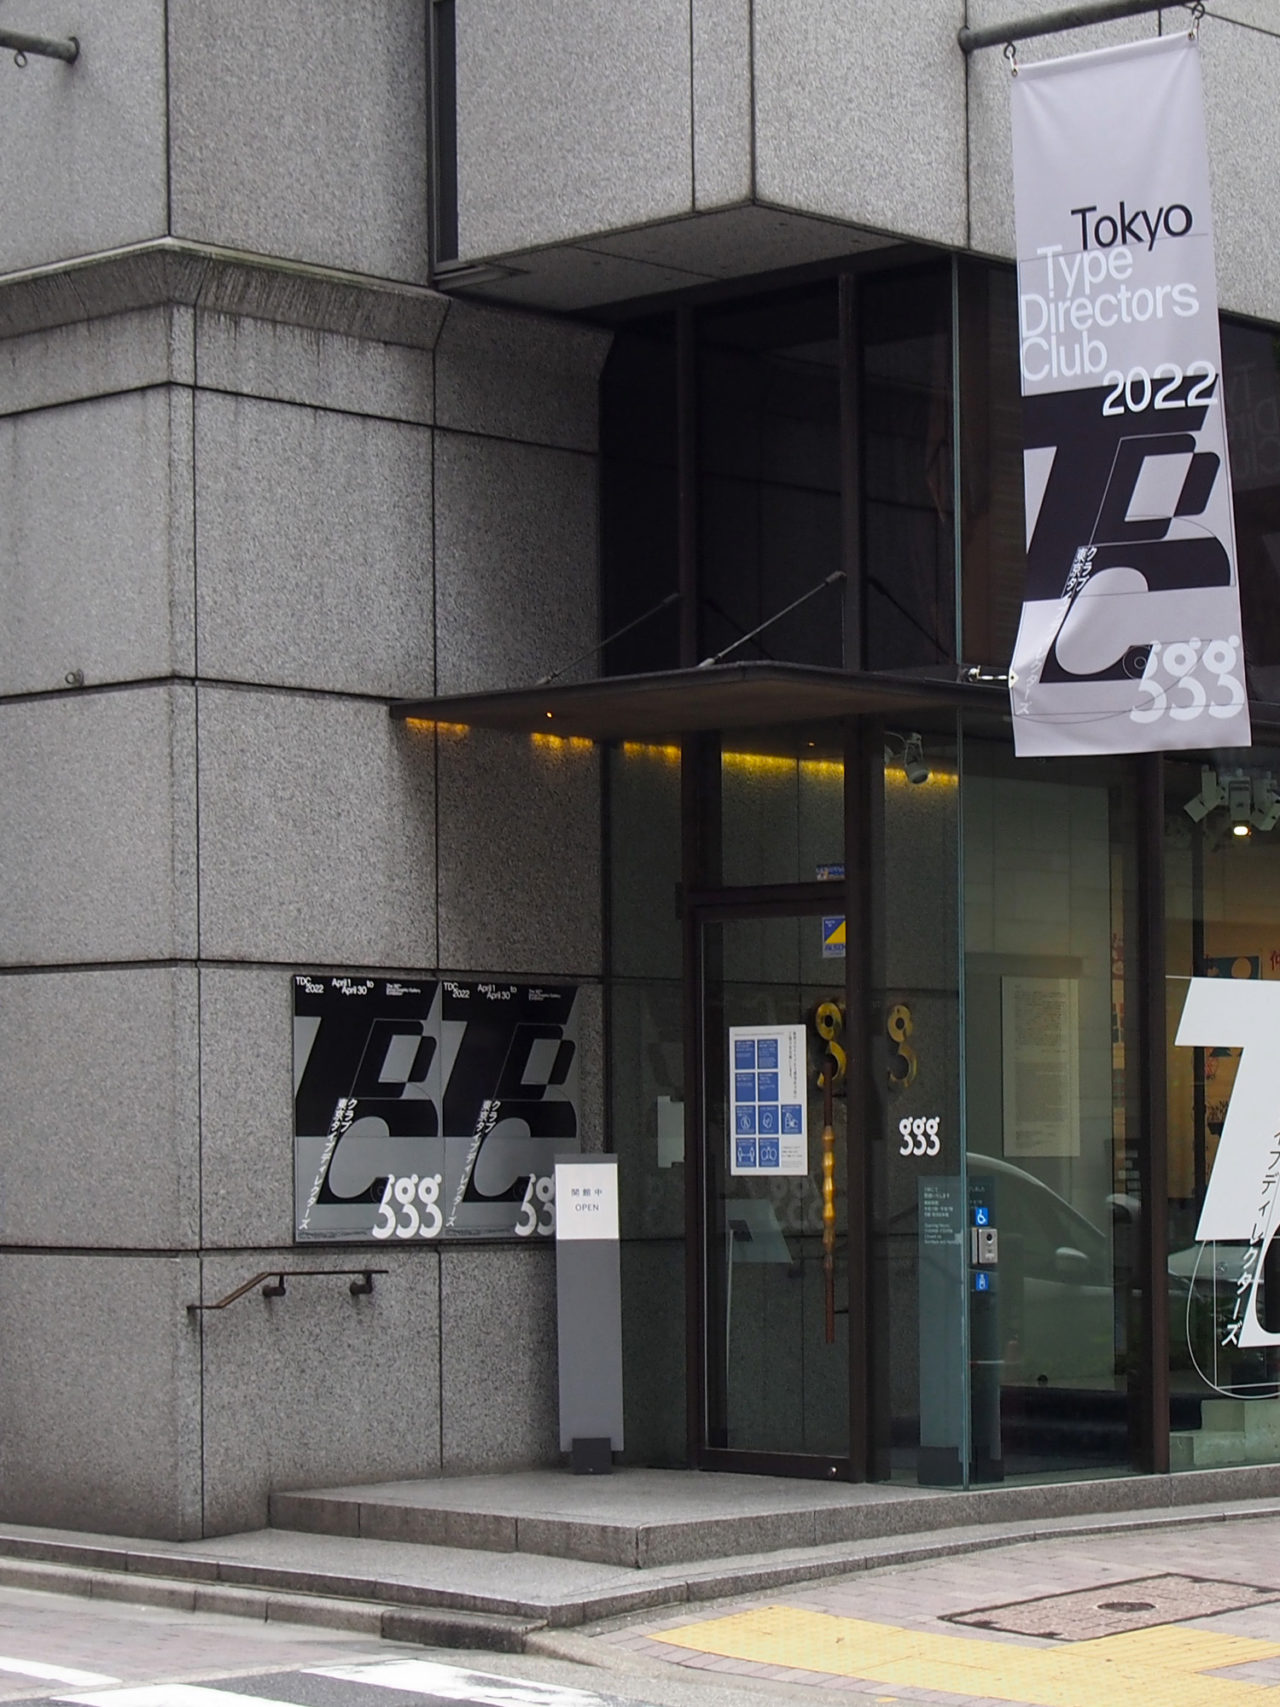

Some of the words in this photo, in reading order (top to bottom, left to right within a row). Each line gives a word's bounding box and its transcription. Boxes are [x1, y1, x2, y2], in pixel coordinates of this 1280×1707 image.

[1070, 201, 1193, 251] Tokyo
[1037, 244, 1133, 297] Type
[1020, 283, 1200, 338] Directors
[1022, 330, 1107, 381] Club
[1102, 360, 1218, 416] 2022
[296, 977, 312, 986] TDC
[366, 980, 374, 989] to
[305, 984, 324, 993] 2022
[444, 982, 458, 991] TDC
[452, 989, 470, 998] 2022
[899, 1116, 940, 1156] ggg
[370, 1173, 443, 1239] ggg
[575, 1204, 599, 1212] OPEN
